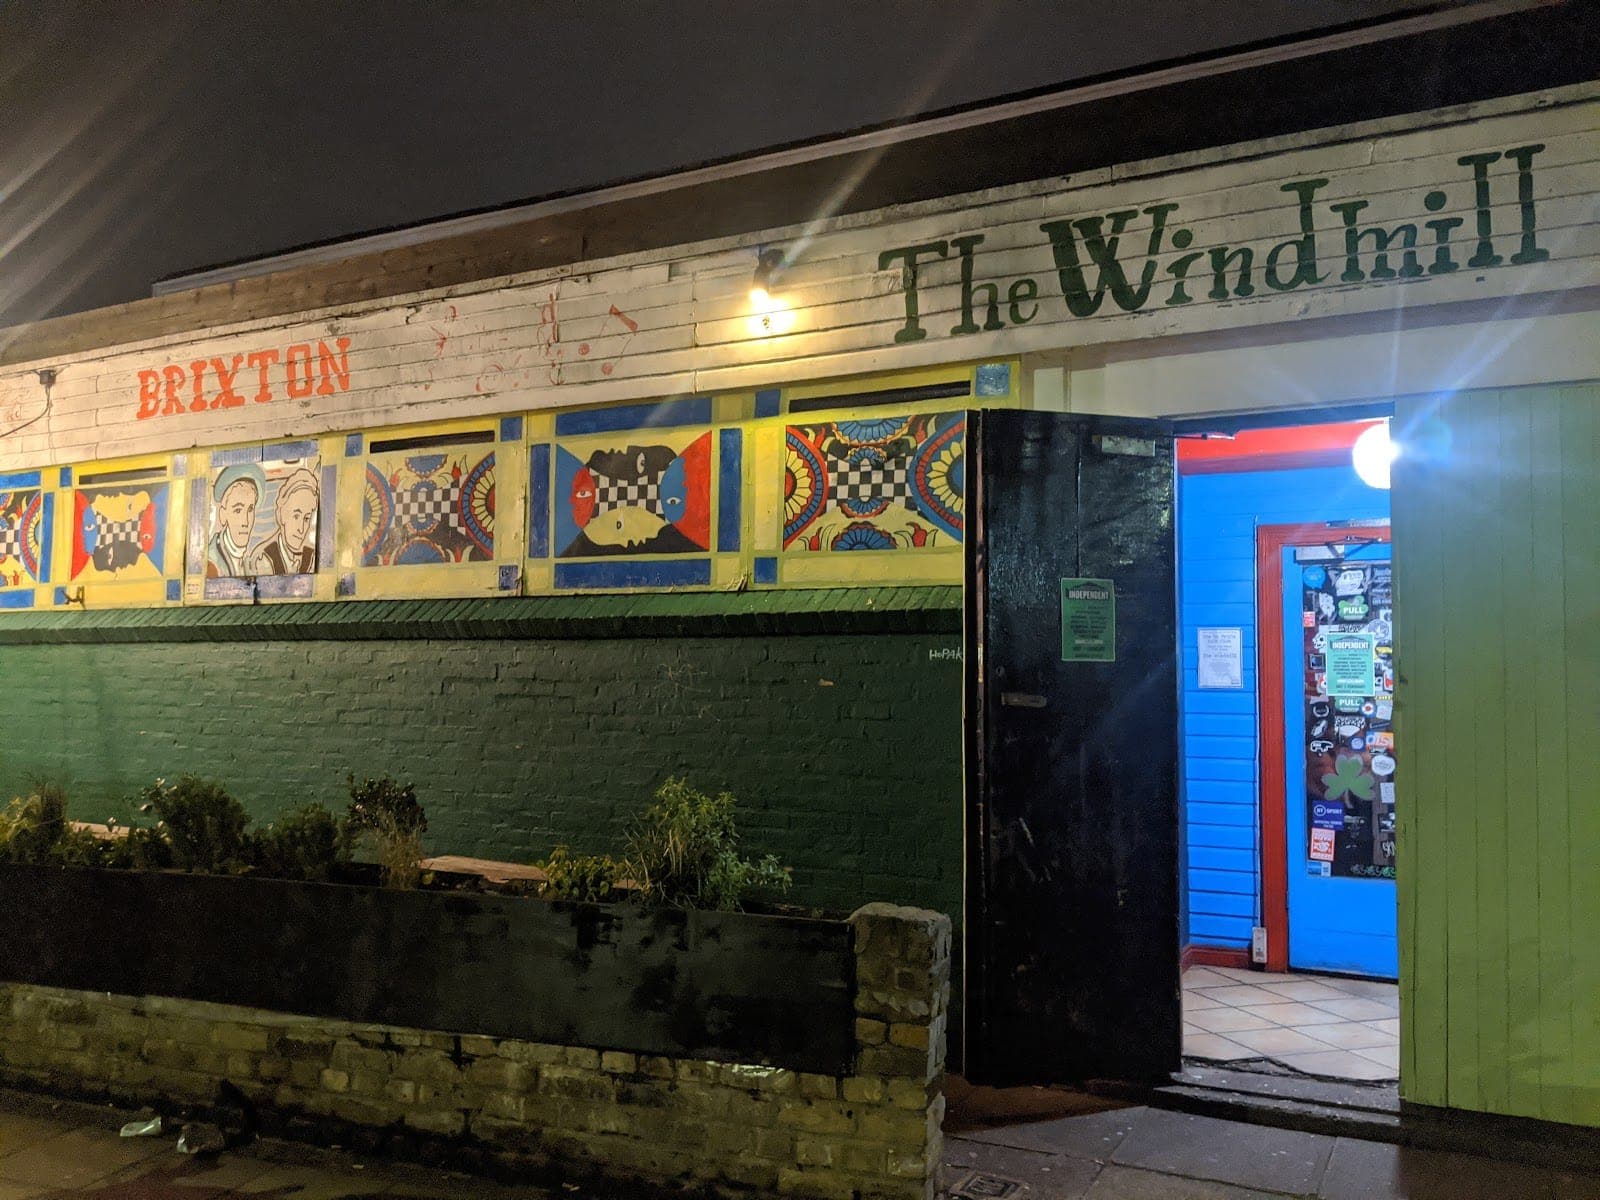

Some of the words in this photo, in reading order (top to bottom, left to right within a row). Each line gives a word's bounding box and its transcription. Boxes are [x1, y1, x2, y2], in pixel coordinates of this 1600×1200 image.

[878, 234, 1039, 343] The
[1040, 144, 1550, 318] Windmill
[136, 337, 351, 420] BRIXTON
[1068, 590, 1109, 600] INDEPENDENT
[1343, 605, 1365, 614] PULL
[1332, 641, 1369, 649] INDEPENDENT
[1340, 698, 1361, 706] PULL
